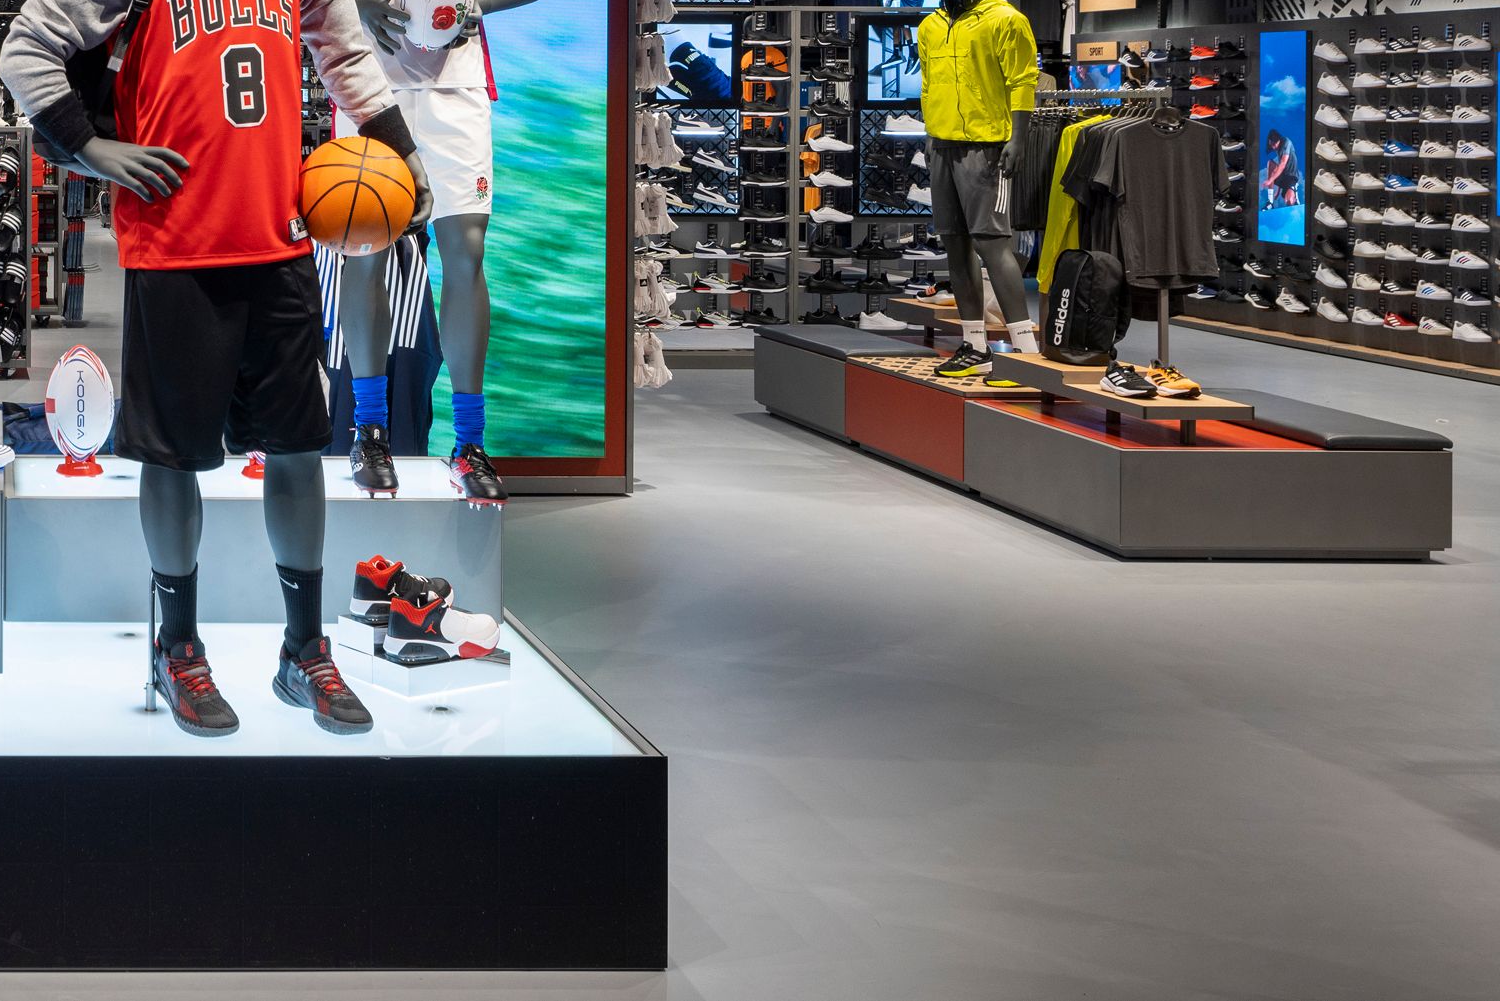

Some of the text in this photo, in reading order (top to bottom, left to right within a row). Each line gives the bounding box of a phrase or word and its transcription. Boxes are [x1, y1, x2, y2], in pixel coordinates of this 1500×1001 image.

[1089, 47, 1104, 57] SPORT
[220, 43, 267, 127] 8
[1053, 288, 1071, 346] adidas
[76, 370, 85, 440] KOOGA
